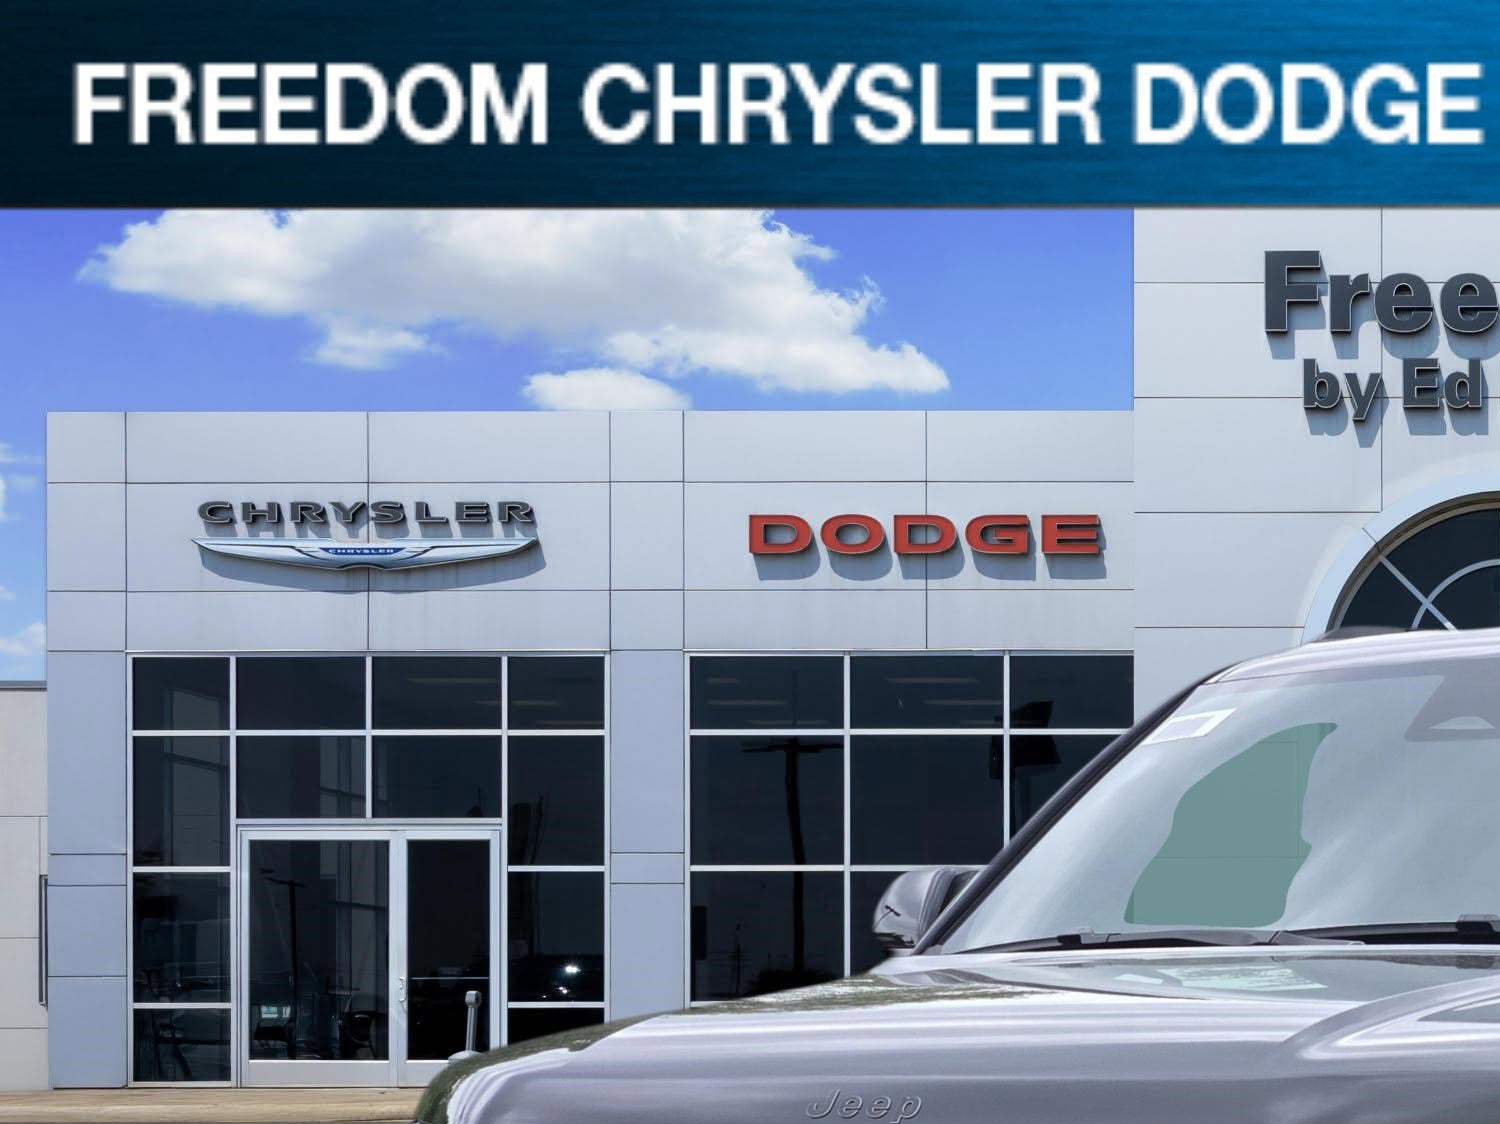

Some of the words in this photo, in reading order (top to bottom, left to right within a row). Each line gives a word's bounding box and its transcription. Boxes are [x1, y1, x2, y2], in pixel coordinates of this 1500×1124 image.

[1302, 357, 1382, 422] by
[1401, 357, 1483, 409] Ed
[196, 500, 535, 525] CHRYSLER
[748, 513, 1102, 555] DODGE
[804, 1088, 923, 1124] Jeep
